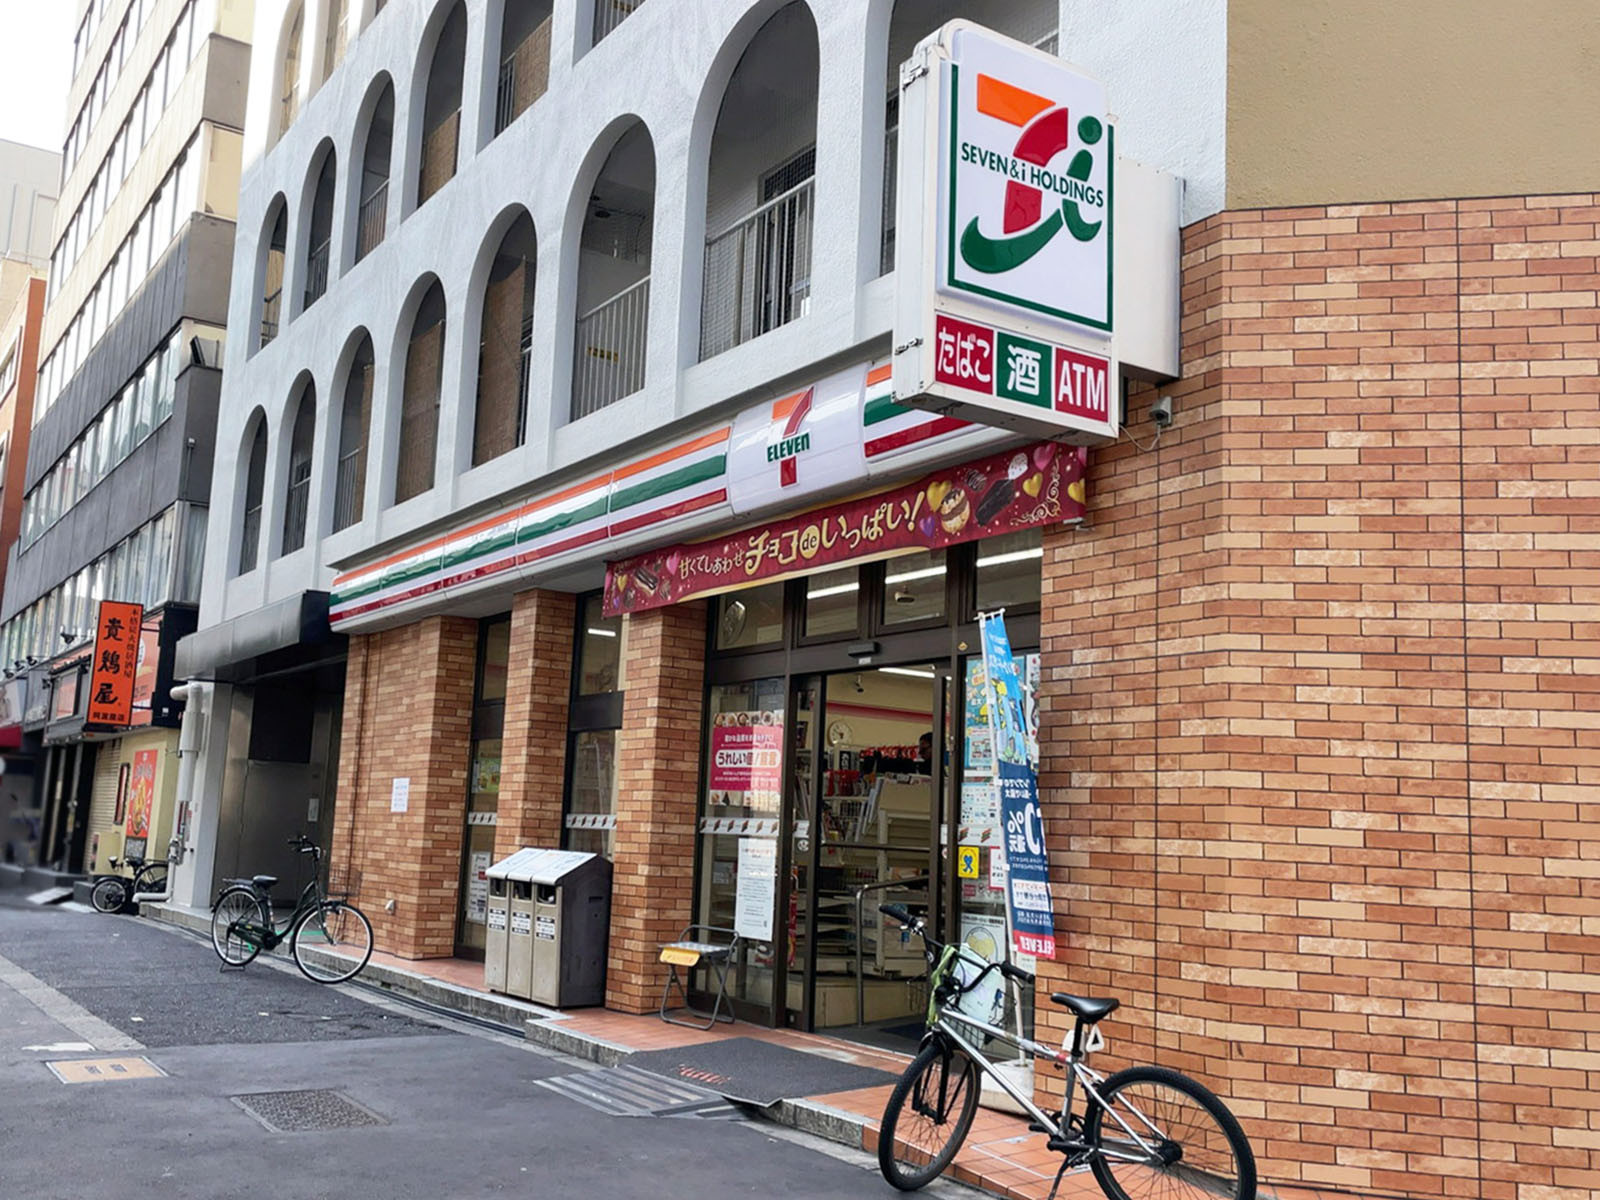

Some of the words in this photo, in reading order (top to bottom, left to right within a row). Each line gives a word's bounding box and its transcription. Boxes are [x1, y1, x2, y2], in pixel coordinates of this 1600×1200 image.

[1030, 166, 1104, 208] HOLDINGS
[938, 326, 991, 383] たばこ
[1007, 344, 1041, 396] 酒
[1058, 360, 1105, 412] ATM
